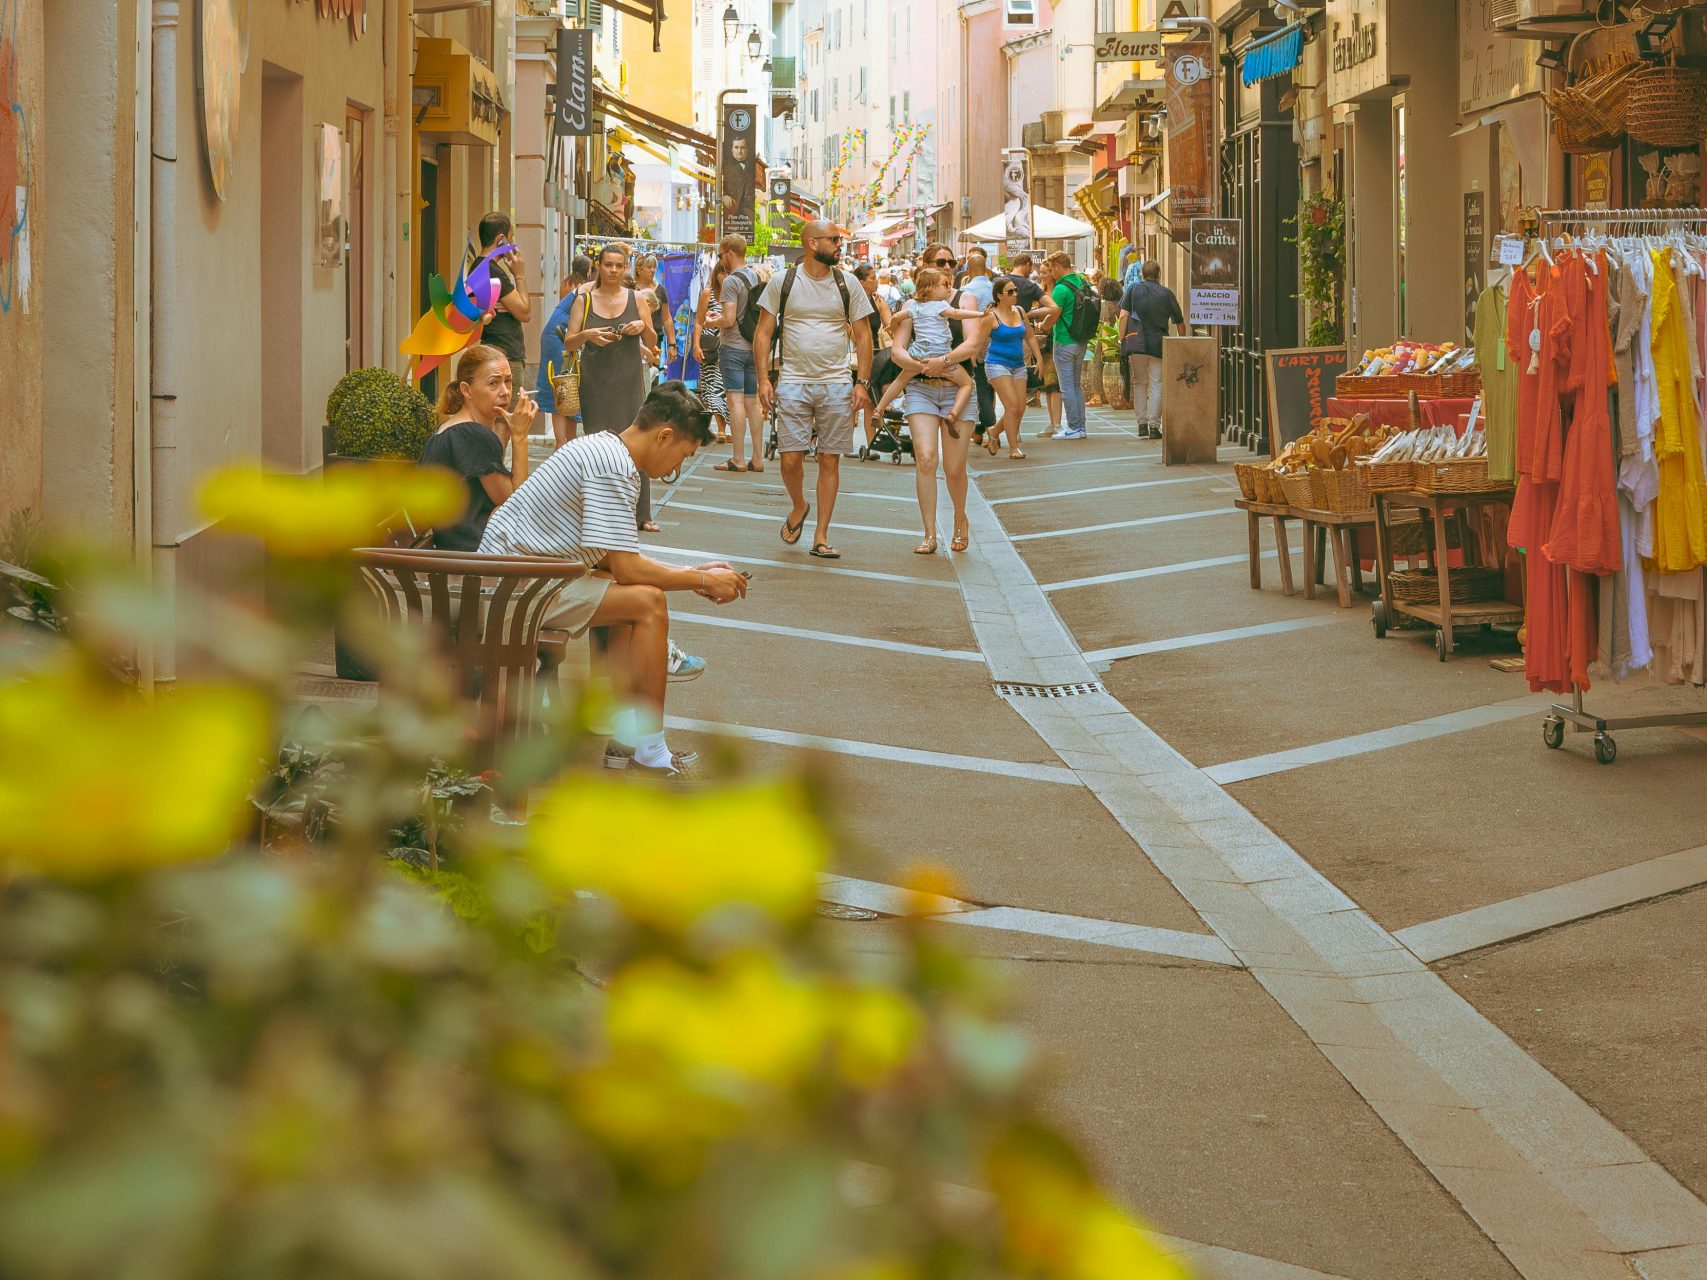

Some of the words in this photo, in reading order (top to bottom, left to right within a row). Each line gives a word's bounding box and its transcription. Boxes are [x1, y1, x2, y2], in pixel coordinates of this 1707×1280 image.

[1096, 37, 1159, 57] Fleurs
[563, 55, 586, 130] Etam
[1195, 231, 1236, 245] Cantu
[1197, 291, 1231, 299] AJACCIO
[1278, 355, 1320, 368] L'ART
[1324, 354, 1346, 364] DU
